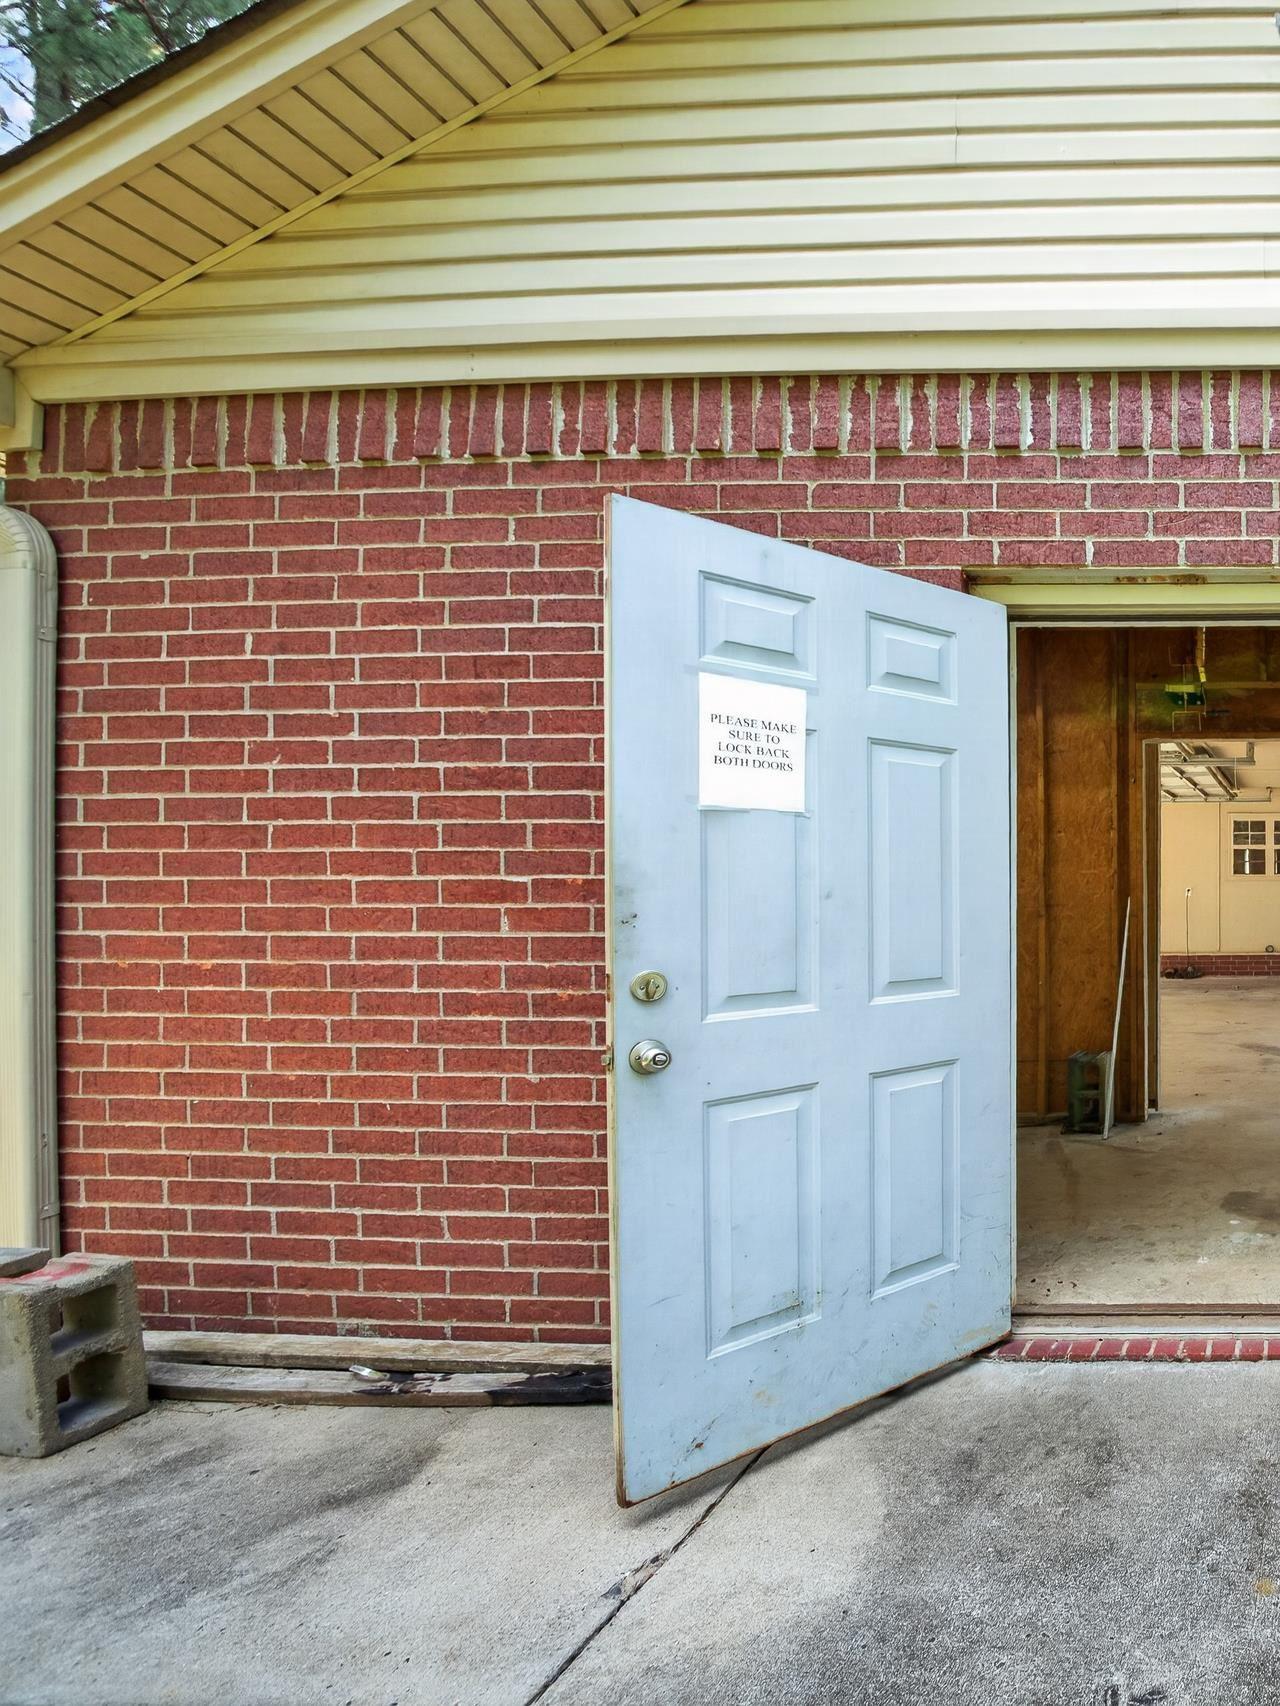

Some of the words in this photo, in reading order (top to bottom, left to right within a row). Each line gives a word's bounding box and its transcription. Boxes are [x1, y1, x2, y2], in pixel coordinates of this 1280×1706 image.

[710, 713, 758, 728] PLEASE
[761, 720, 797, 734] MAKE
[728, 730, 761, 742] SURE
[765, 734, 780, 745] TO
[718, 741, 752, 754] LOCK
[756, 746, 790, 759] BACK
[714, 755, 749, 767] BOTH
[752, 759, 793, 772] DOORS
